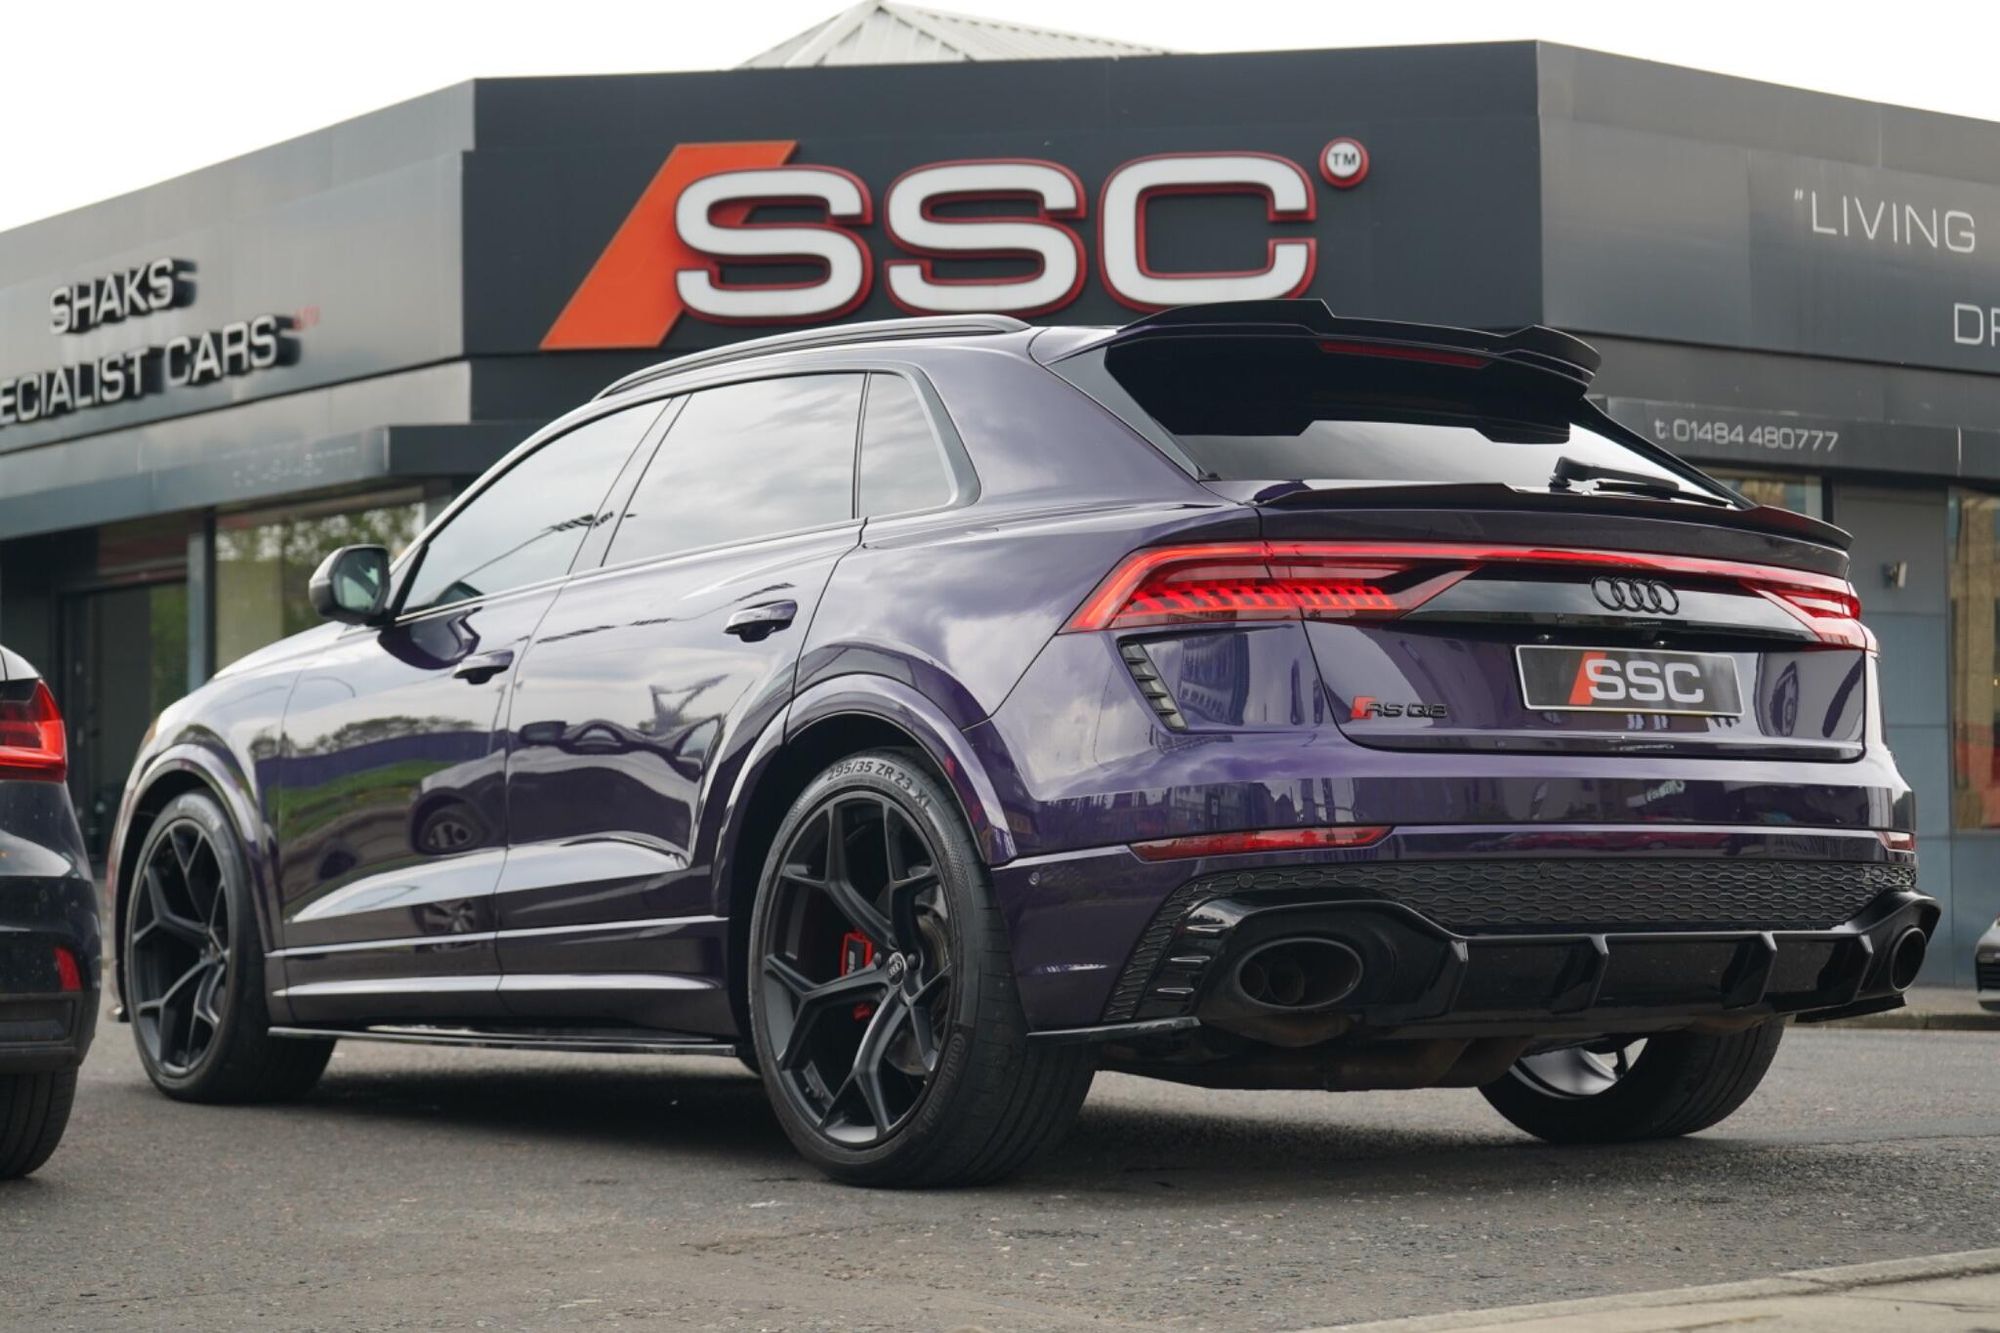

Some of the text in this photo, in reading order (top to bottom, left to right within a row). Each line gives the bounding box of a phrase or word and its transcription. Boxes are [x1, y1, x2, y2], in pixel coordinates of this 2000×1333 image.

[1331, 152, 1357, 167] TM
[674, 153, 1316, 324] SSC
[50, 257, 176, 335] SHAKS
[0, 350, 150, 425] ECIALIST
[164, 314, 279, 388] CARS
[1749, 426, 1840, 452] 480777
[1585, 659, 1705, 704] SSC
[826, 760, 874, 781] 295/35
[875, 763, 895, 779] ZR
[894, 771, 913, 791] 23
